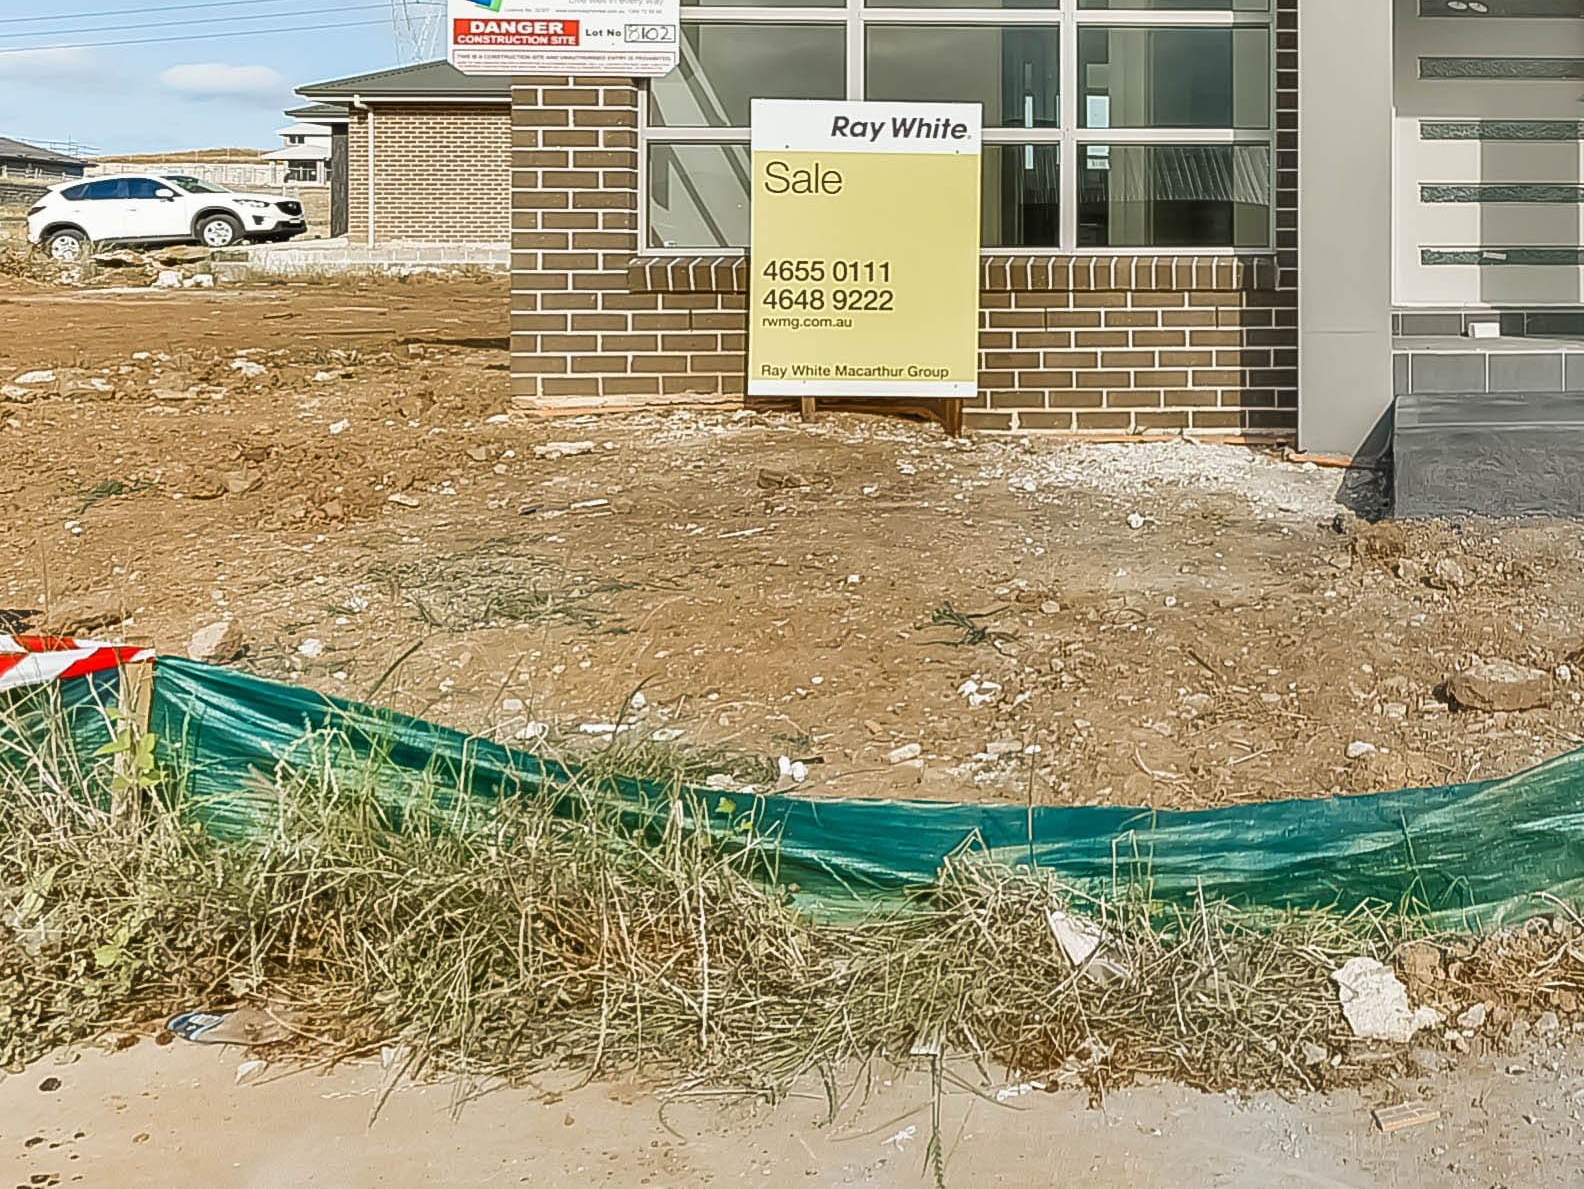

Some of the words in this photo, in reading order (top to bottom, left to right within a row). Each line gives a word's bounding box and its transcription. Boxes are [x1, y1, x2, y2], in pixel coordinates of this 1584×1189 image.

[470, 21, 564, 35] DANGER
[585, 28, 603, 37] Lot
[607, 29, 622, 38] No
[457, 35, 550, 45] CONSTRUCTION
[551, 36, 577, 46] SITE
[831, 115, 886, 143] Ray
[891, 117, 968, 140] White
[764, 161, 843, 194] Sale
[763, 261, 825, 281] 4655
[832, 261, 890, 282] 0111
[762, 289, 825, 310] 4648
[832, 290, 894, 311] 9222
[762, 317, 853, 330] rwmg.com.au
[761, 364, 788, 379] Ray
[792, 365, 831, 377] White
[835, 365, 904, 378] Macarthur
[907, 366, 950, 379] Group
